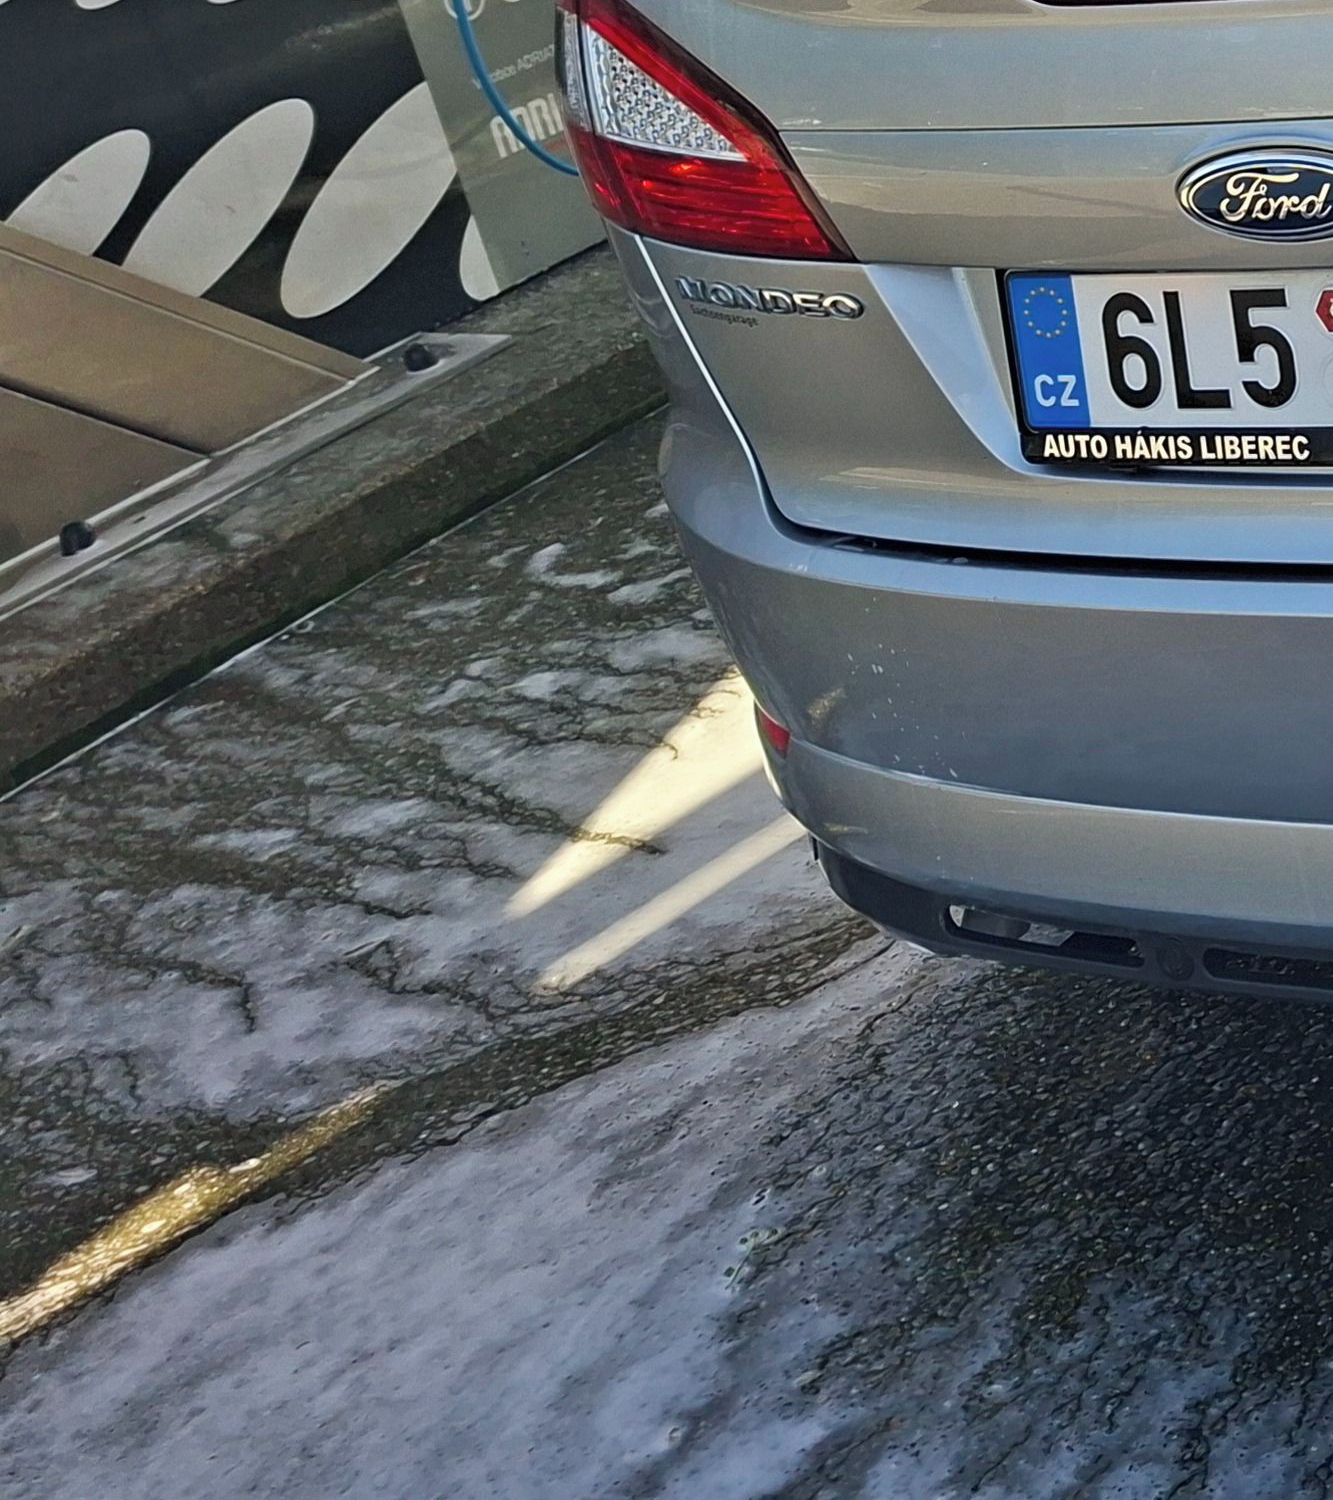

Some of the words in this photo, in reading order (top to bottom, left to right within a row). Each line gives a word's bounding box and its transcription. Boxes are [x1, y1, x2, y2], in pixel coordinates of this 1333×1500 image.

[1220, 172, 1333, 222] Ford
[675, 275, 865, 319] MONDEO
[1101, 287, 1298, 410] 6L5
[1034, 374, 1080, 408] CZ
[1044, 434, 1108, 459] AUTO
[1114, 430, 1193, 460] HÁKIS
[1200, 435, 1310, 460] LIBEREC
